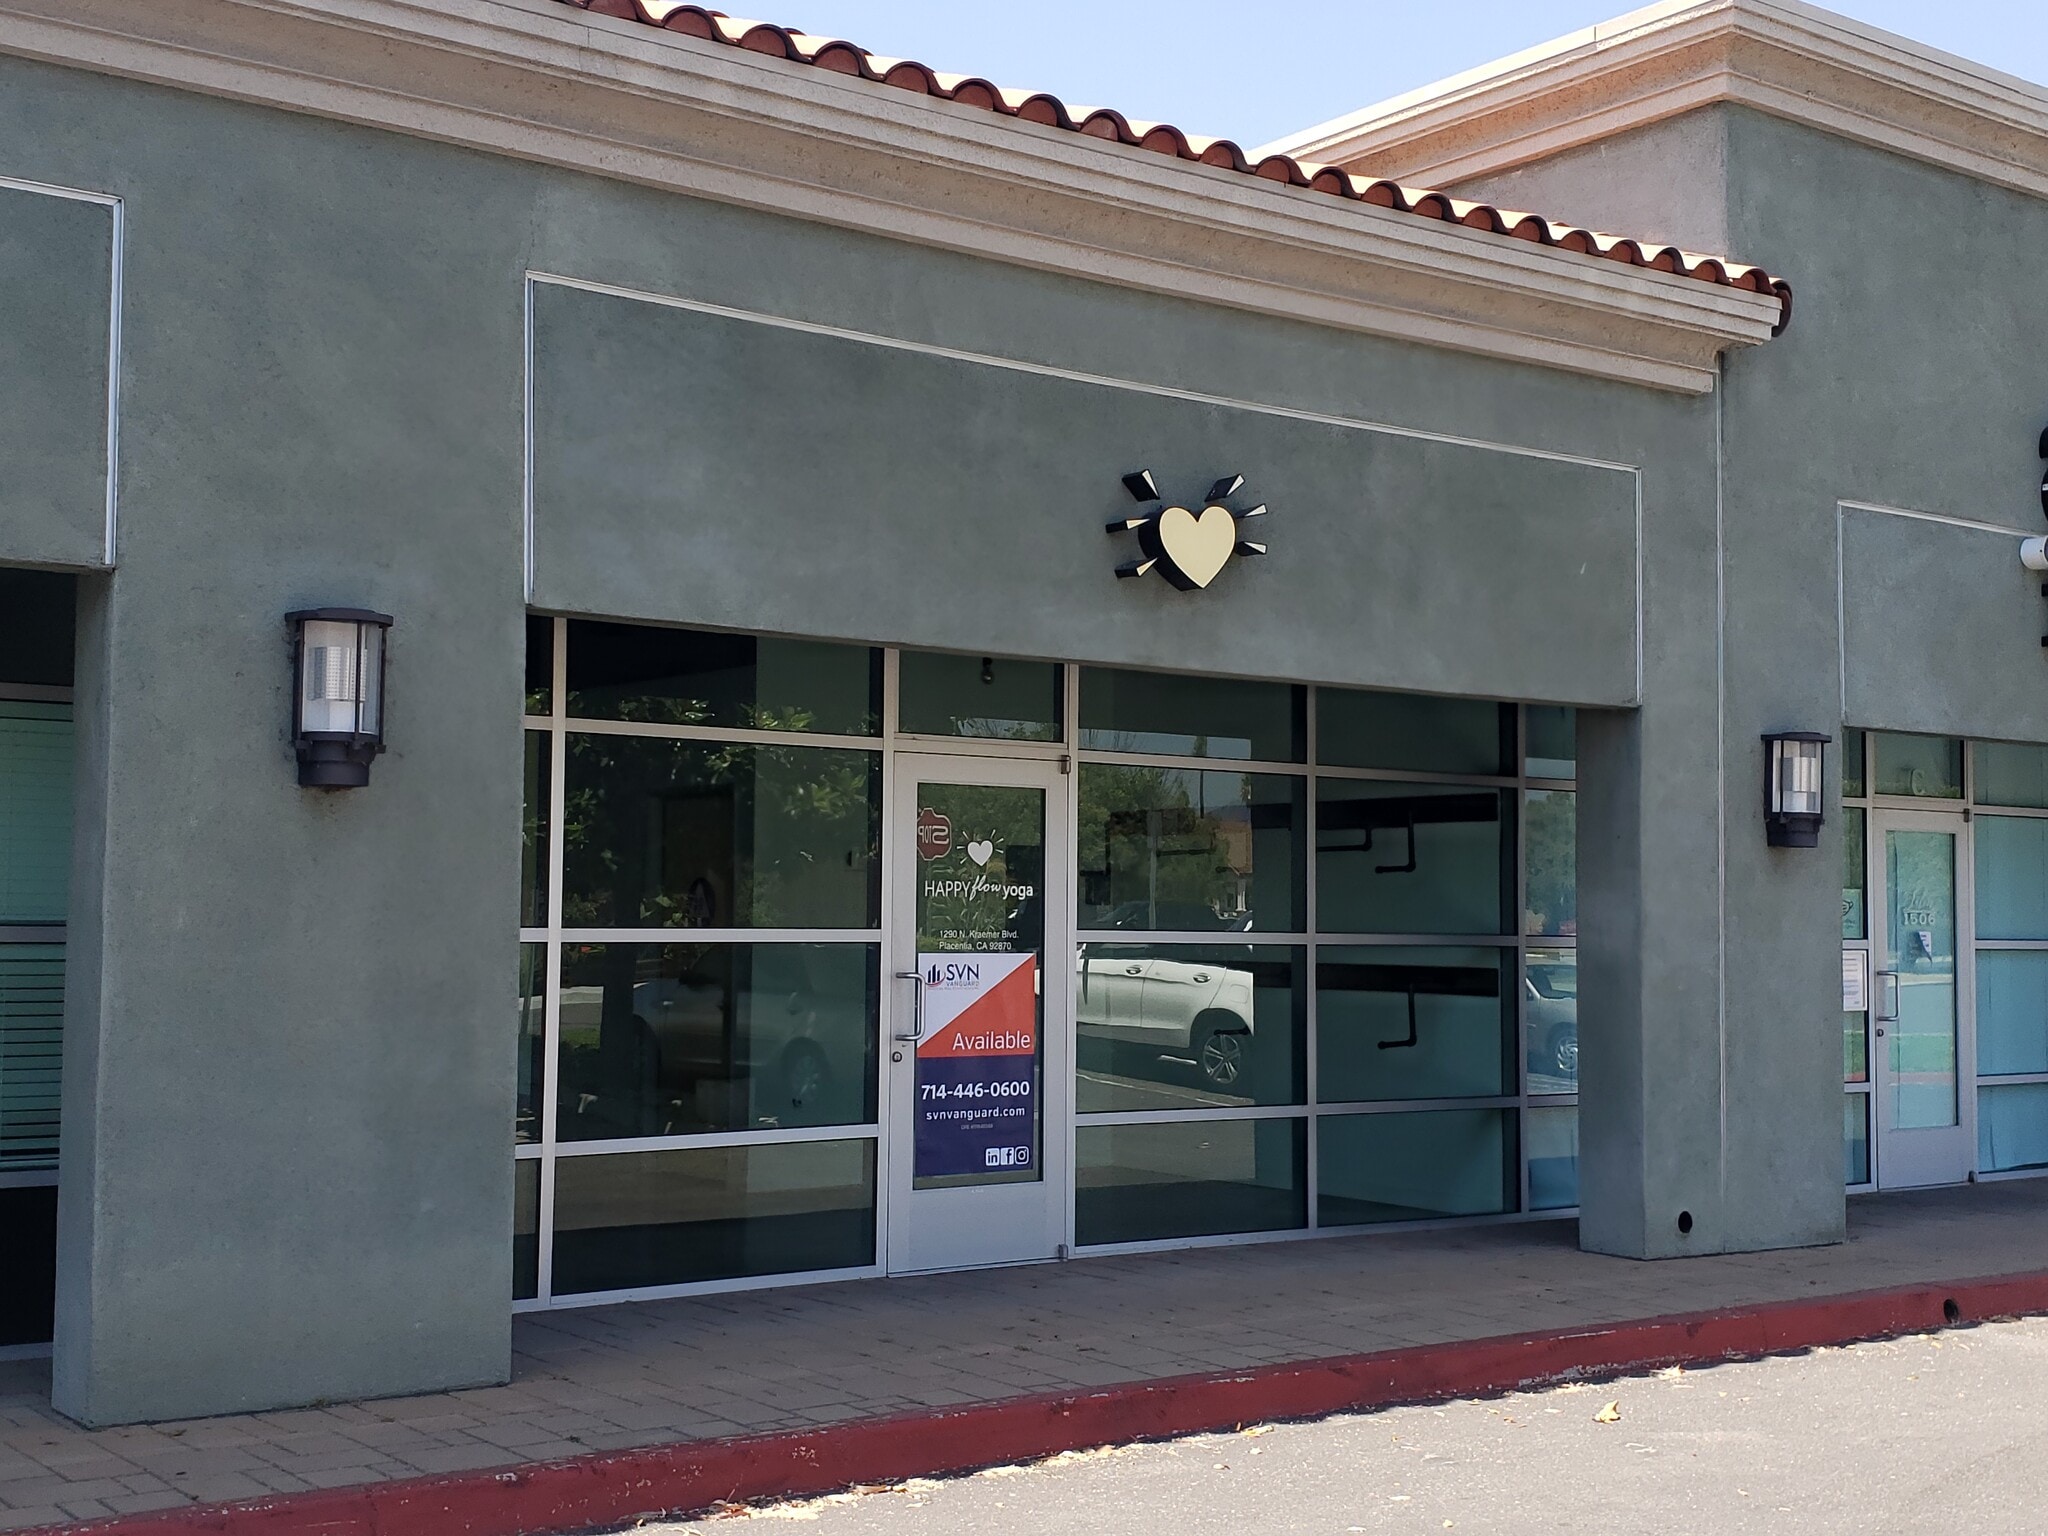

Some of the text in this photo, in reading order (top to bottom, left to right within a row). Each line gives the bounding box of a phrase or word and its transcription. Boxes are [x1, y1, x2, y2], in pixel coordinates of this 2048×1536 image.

[924, 874, 1033, 901] HAPPY flow yoga
[1903, 911, 1936, 925] 1506
[940, 930, 957, 938] 1290
[969, 930, 1000, 938] Kraemer
[1001, 930, 1019, 938] Blvd.
[976, 942, 988, 950] CA
[989, 942, 1012, 950] 92870
[946, 963, 979, 981] SVN
[953, 1030, 1031, 1051] Available
[921, 1081, 1030, 1100] 714-446-0600
[926, 1106, 1025, 1121] svnvanguard.com
